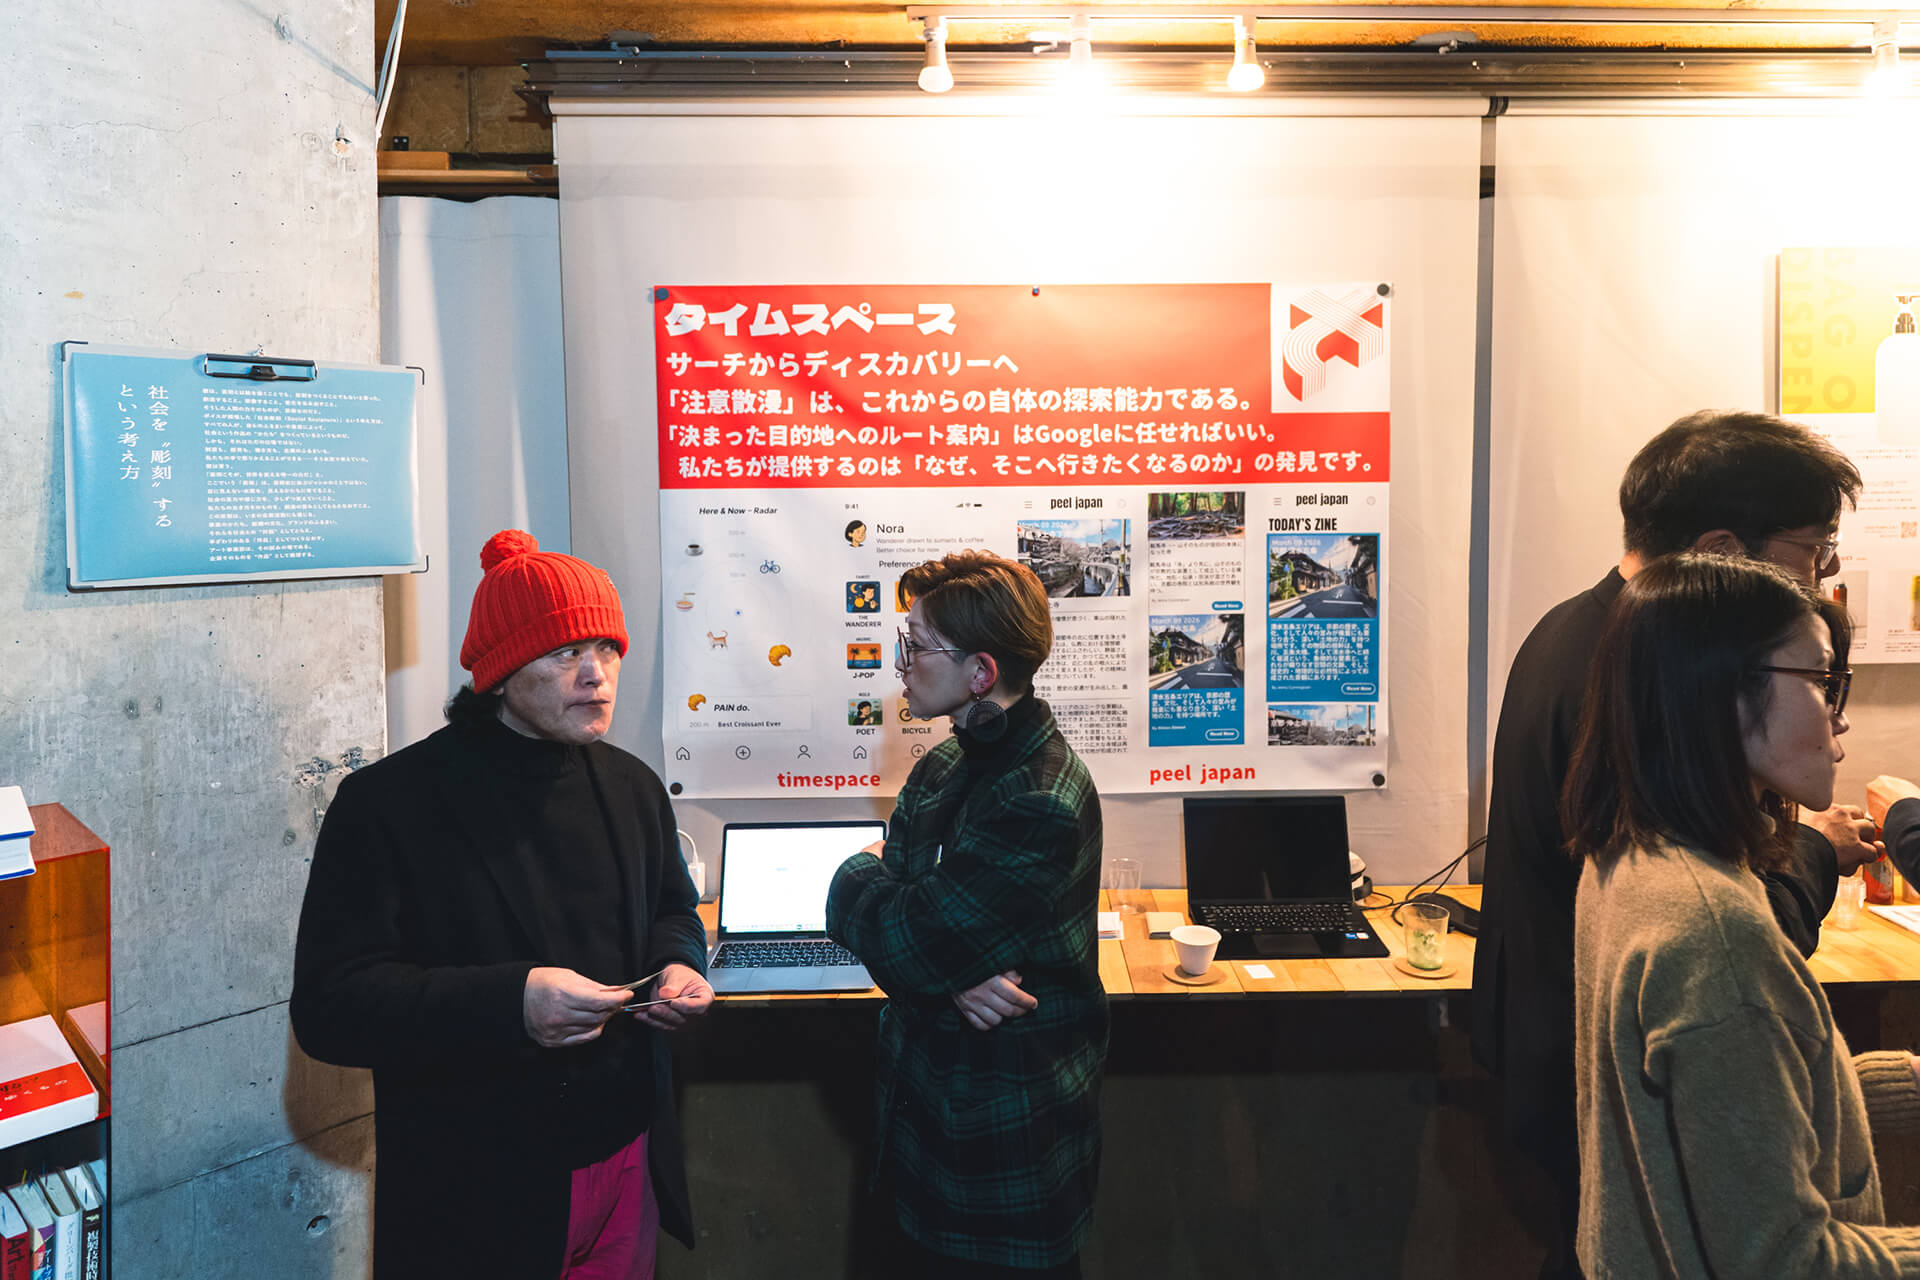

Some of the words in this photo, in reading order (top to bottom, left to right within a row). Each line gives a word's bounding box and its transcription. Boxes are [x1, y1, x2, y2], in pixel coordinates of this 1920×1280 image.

[664, 303, 957, 337] タイムスペース
[666, 351, 1019, 378] サーチからディスカバリーへ
[117, 383, 140, 481] という考え方
[1050, 497, 1072, 510] peel
[1075, 496, 1103, 510] japan
[1296, 494, 1317, 506] peel
[1320, 493, 1348, 506] japan
[699, 507, 718, 515] Here
[727, 507, 746, 515] Now
[753, 506, 778, 515] Radar
[876, 523, 905, 534] Nora
[1314, 518, 1338, 530] ZINE
[878, 560, 921, 569] Preference
[713, 703, 735, 712] PAIN
[736, 703, 750, 712] do.
[733, 720, 765, 728] Croissant
[777, 771, 881, 790] timespace
[1150, 764, 1191, 785] peel
[1199, 763, 1256, 784] japan
